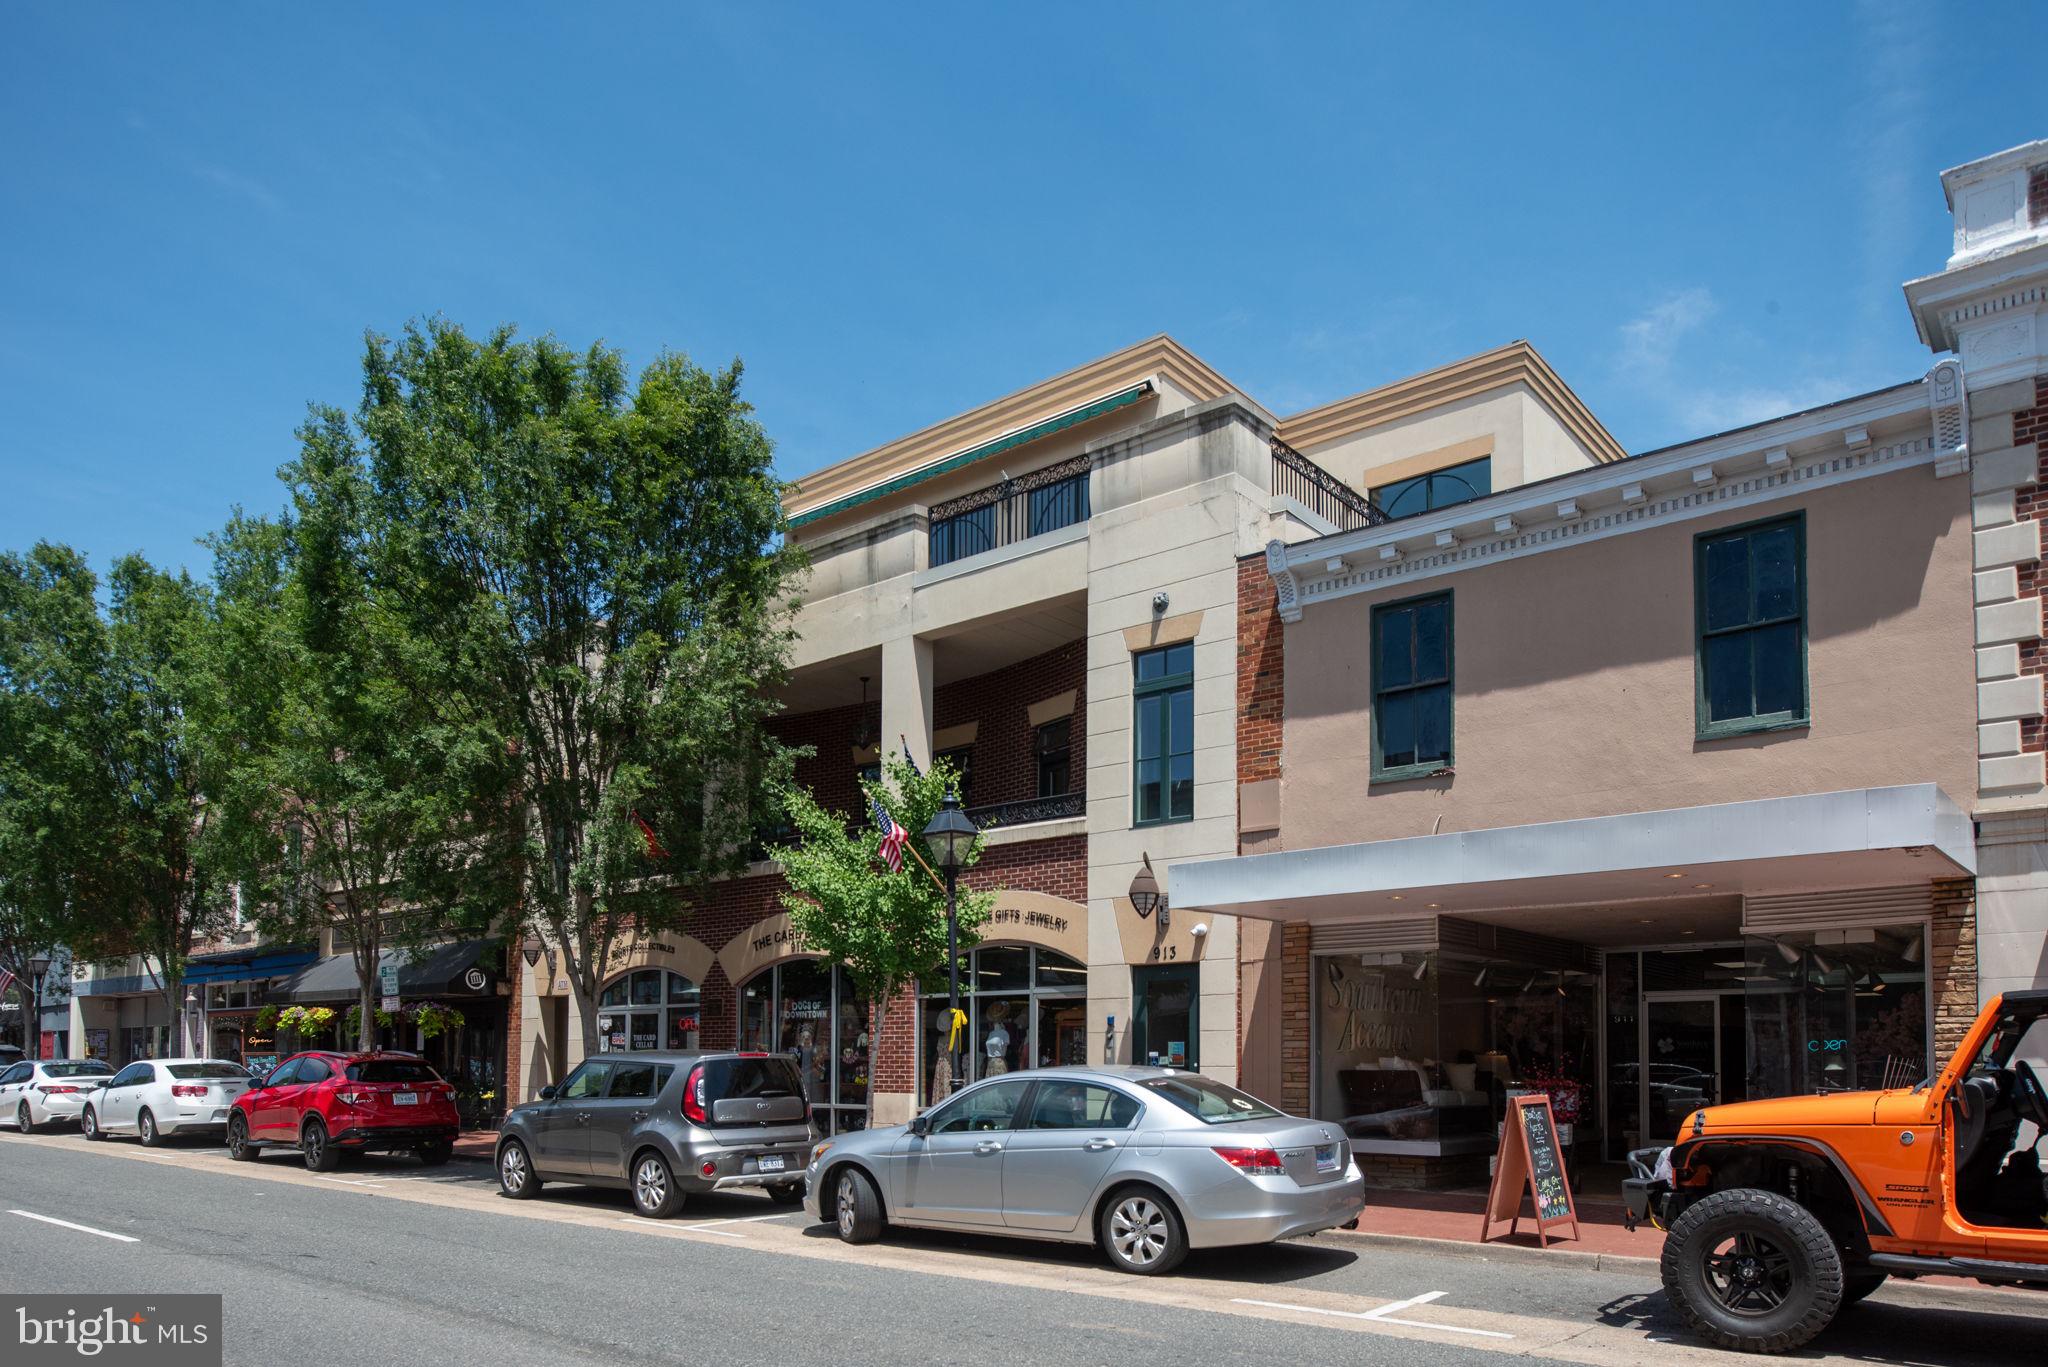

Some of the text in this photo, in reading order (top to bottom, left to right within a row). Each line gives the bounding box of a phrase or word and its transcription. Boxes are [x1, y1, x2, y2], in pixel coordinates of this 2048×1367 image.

[995, 909, 1020, 920] GIFTS
[1025, 910, 1068, 930] JEWELRY
[753, 935, 772, 952] THE
[1153, 945, 1176, 960] 913
[1327, 976, 1423, 1013] Southern
[792, 1001, 822, 1011] DOGS OF
[785, 1010, 828, 1019] DOWNTOWN
[1336, 1009, 1413, 1053] Accents
[249, 1036, 273, 1047] Open
[1886, 1184, 1929, 1192] SPORT
[1877, 1196, 1935, 1205] WRANGLER
